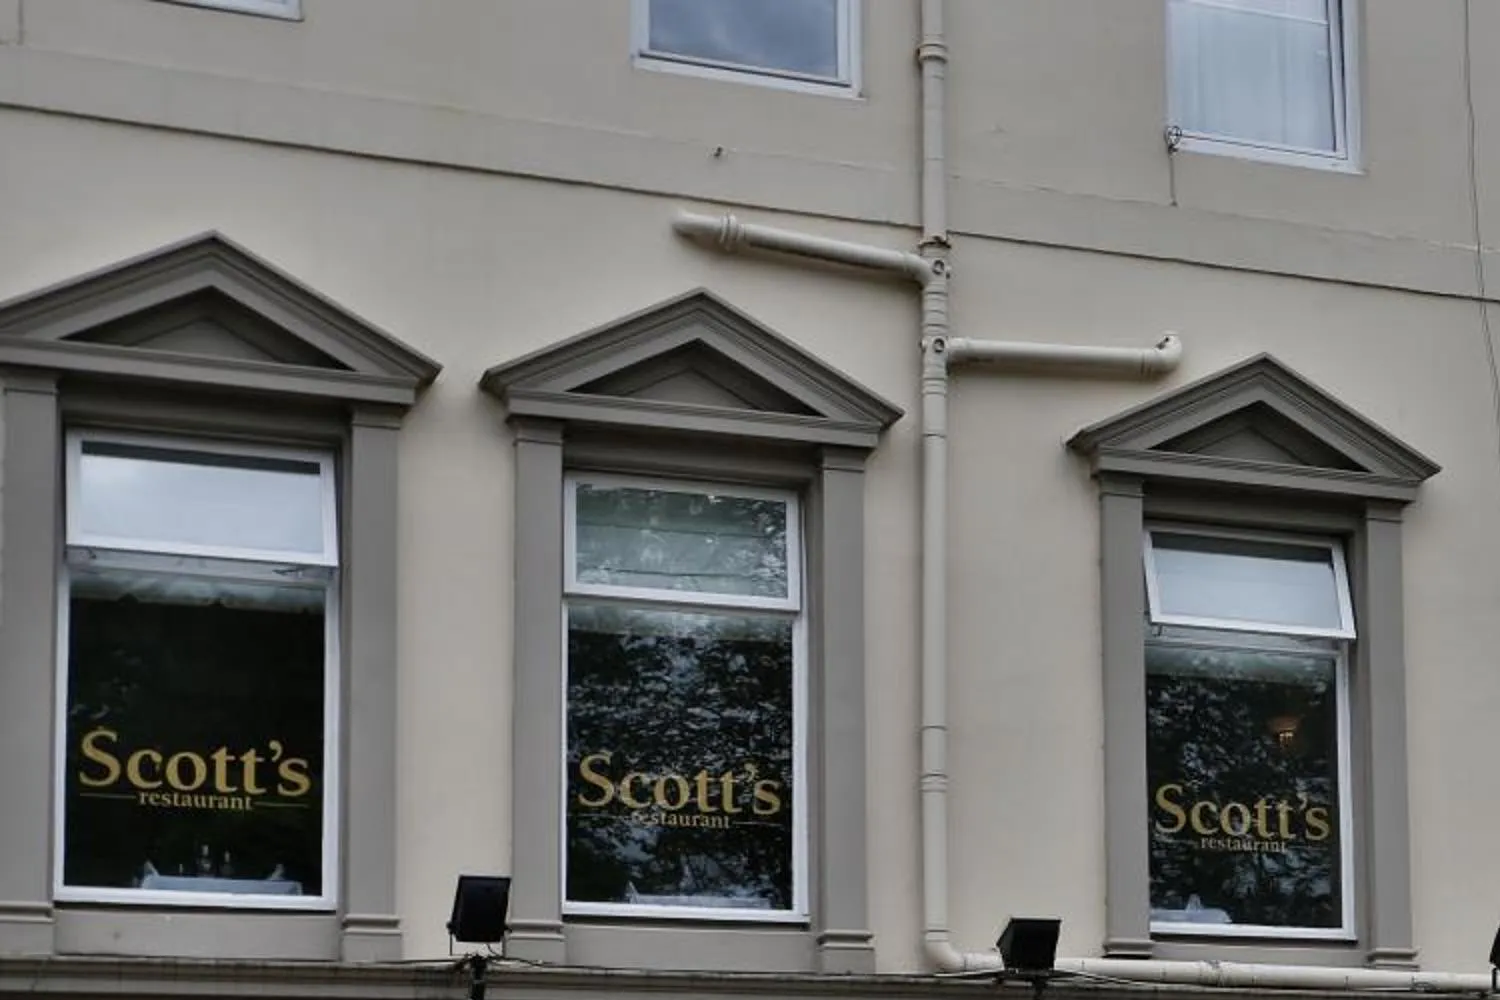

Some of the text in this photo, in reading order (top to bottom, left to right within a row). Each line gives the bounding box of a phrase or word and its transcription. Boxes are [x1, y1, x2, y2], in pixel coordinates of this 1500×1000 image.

[80, 729, 311, 797] Scott's
[578, 752, 781, 815] Scott's
[138, 791, 254, 811] restaurant
[1155, 783, 1330, 841] Scott's
[1200, 837, 1287, 852] restaurant
